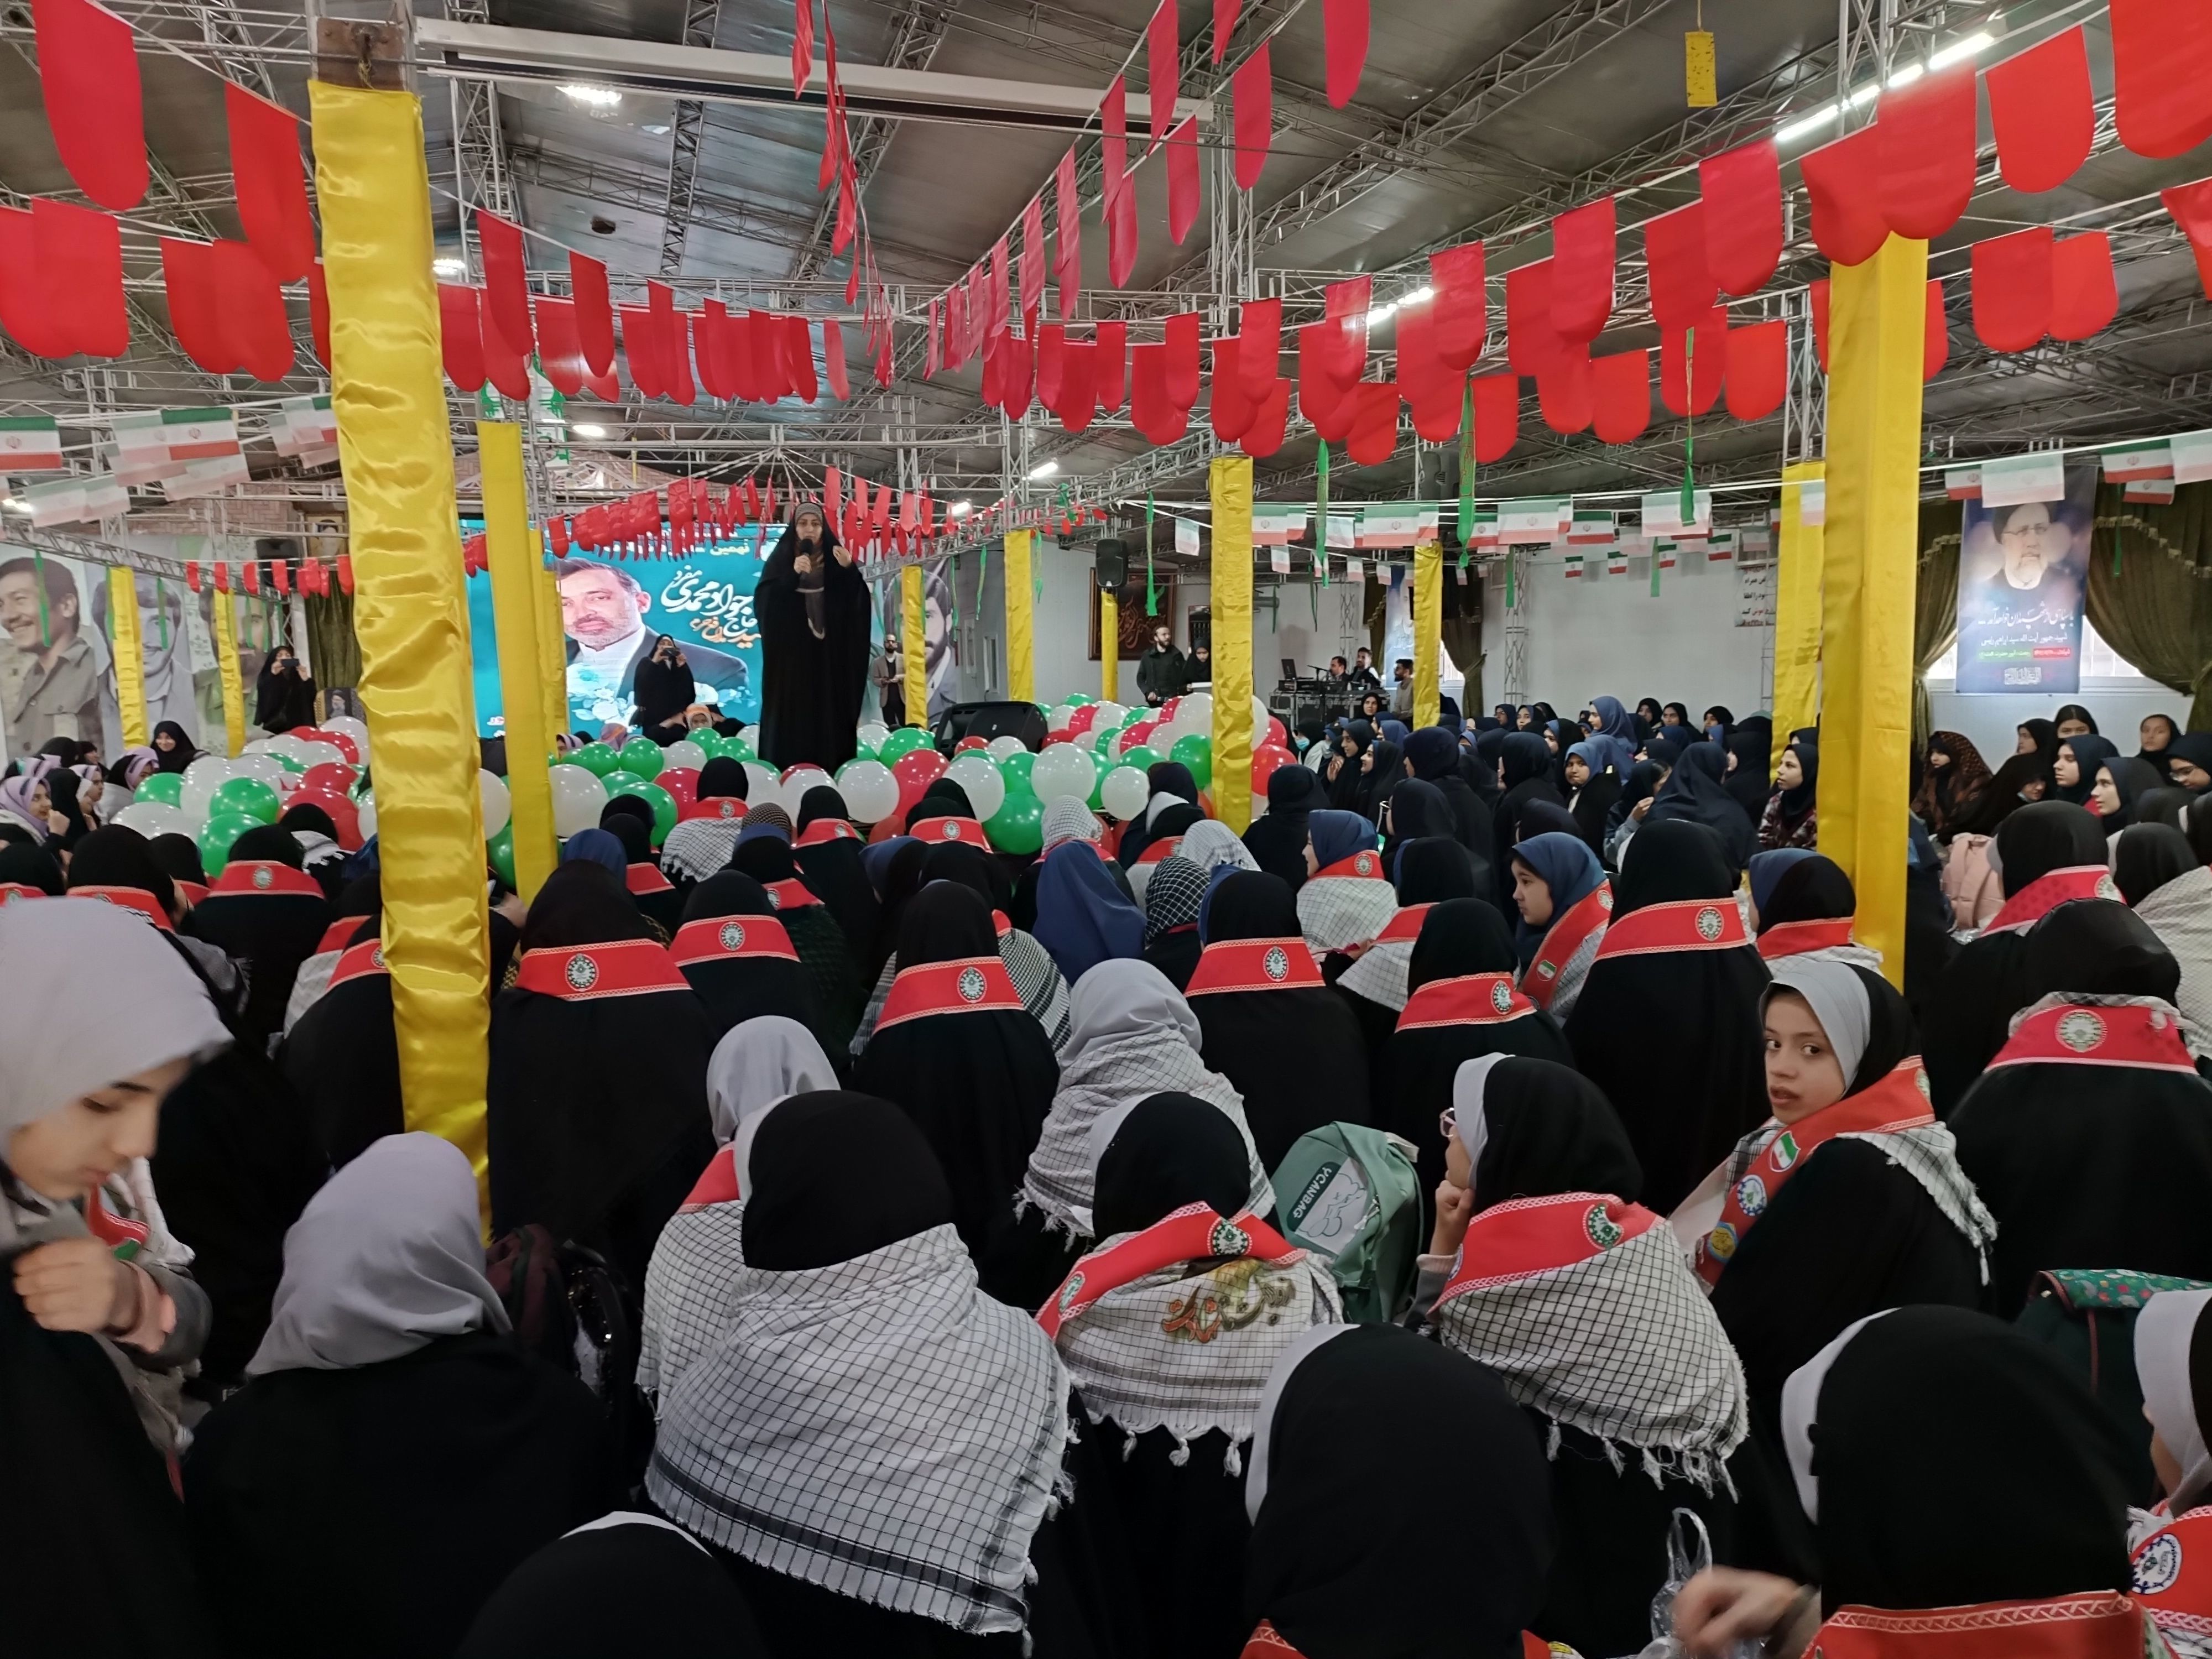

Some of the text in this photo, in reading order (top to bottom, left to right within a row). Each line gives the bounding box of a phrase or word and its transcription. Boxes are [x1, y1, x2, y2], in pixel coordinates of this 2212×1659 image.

[661, 578, 720, 613] محمدی
[700, 583, 754, 618] جواد
[723, 615, 758, 637] حاج
[1292, 1167, 1332, 1218] YCANBAG
